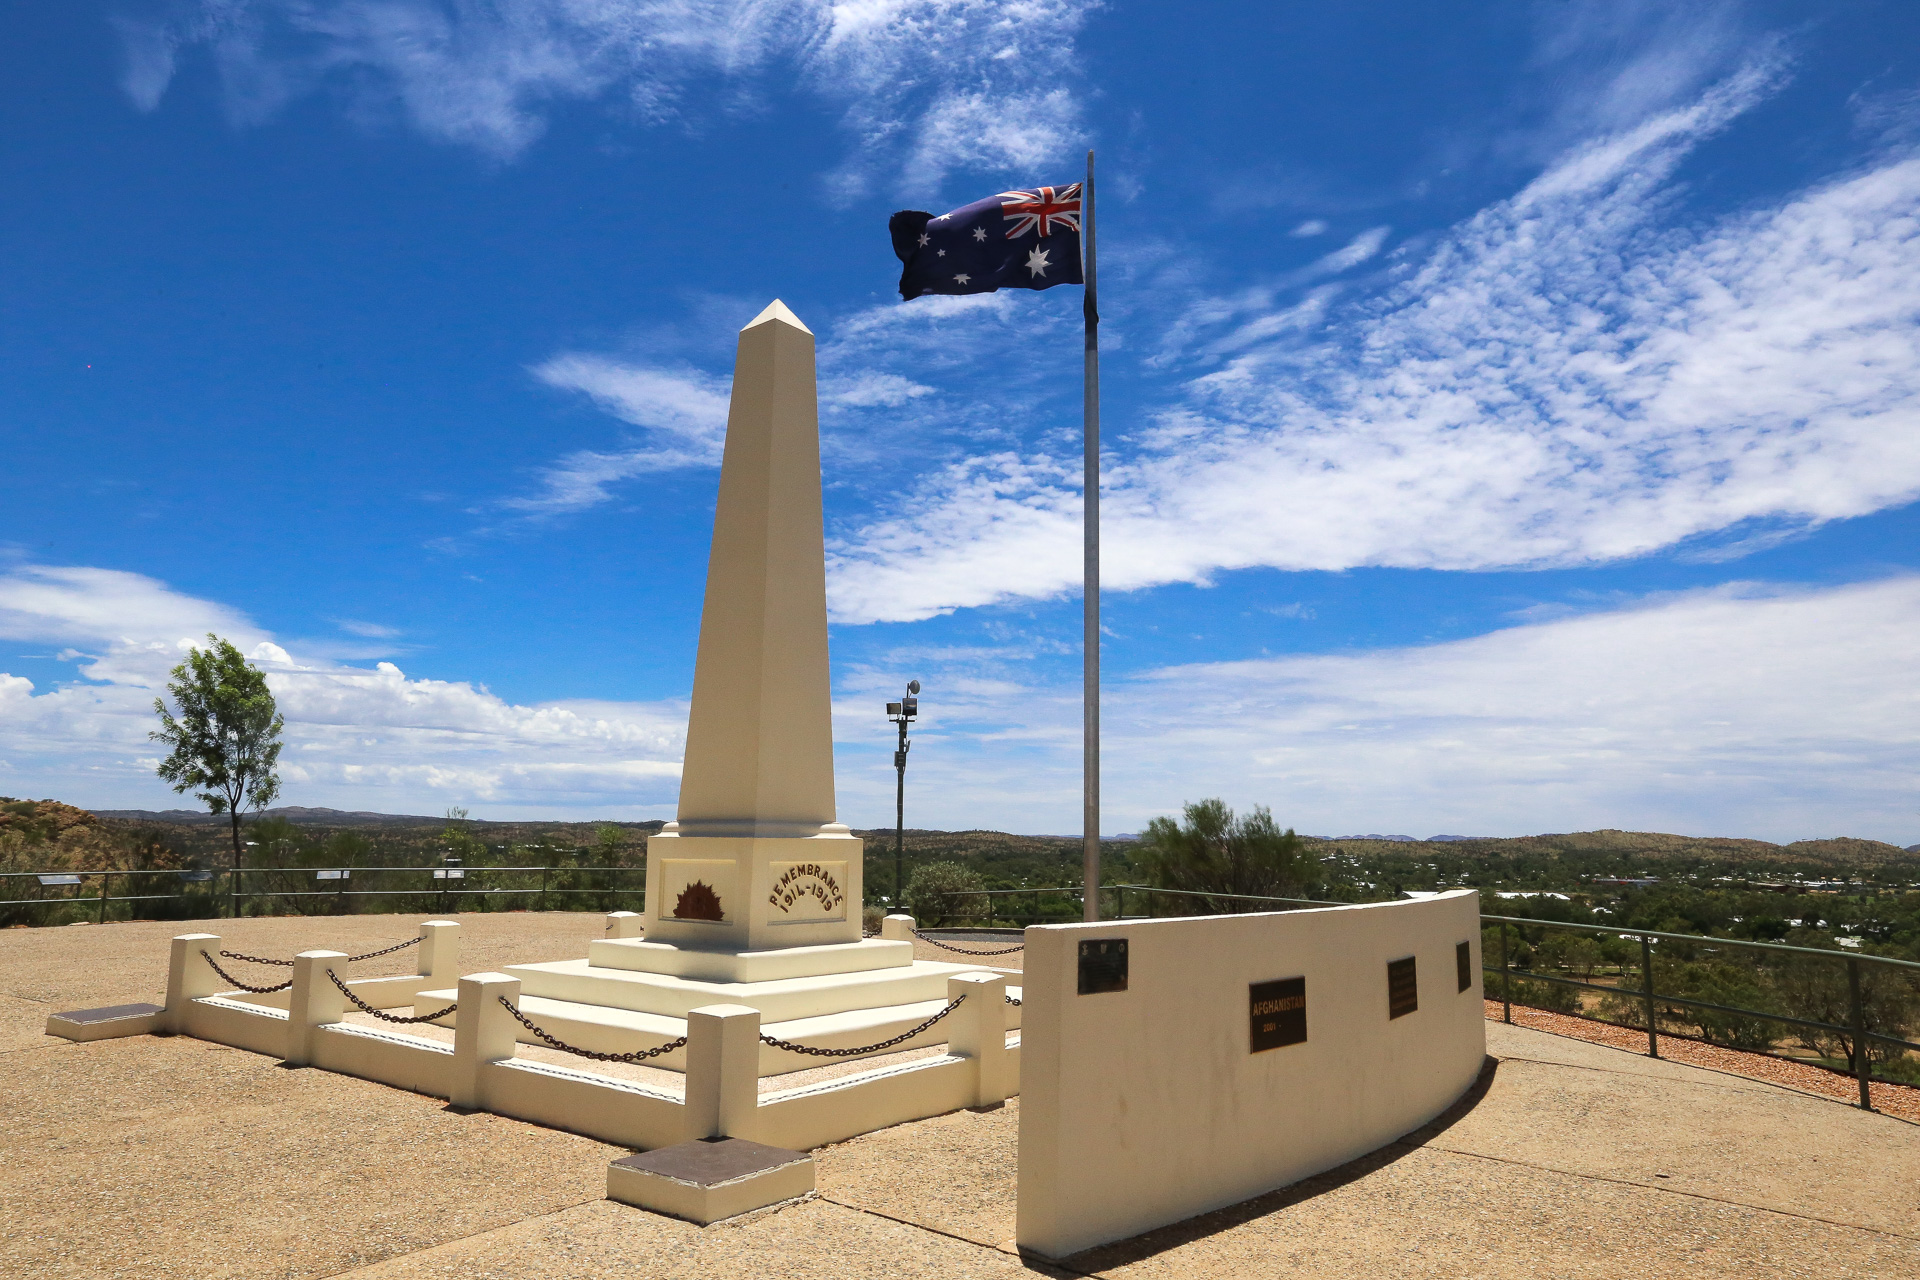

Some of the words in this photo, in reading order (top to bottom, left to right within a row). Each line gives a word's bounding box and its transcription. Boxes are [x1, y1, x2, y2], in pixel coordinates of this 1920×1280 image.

[770, 864, 843, 906] REMEMBRANCE
[780, 884, 832, 913] 1914-1919
[1252, 995, 1304, 1016] AFGHANISTAN
[1263, 1022, 1276, 1032] 2001
